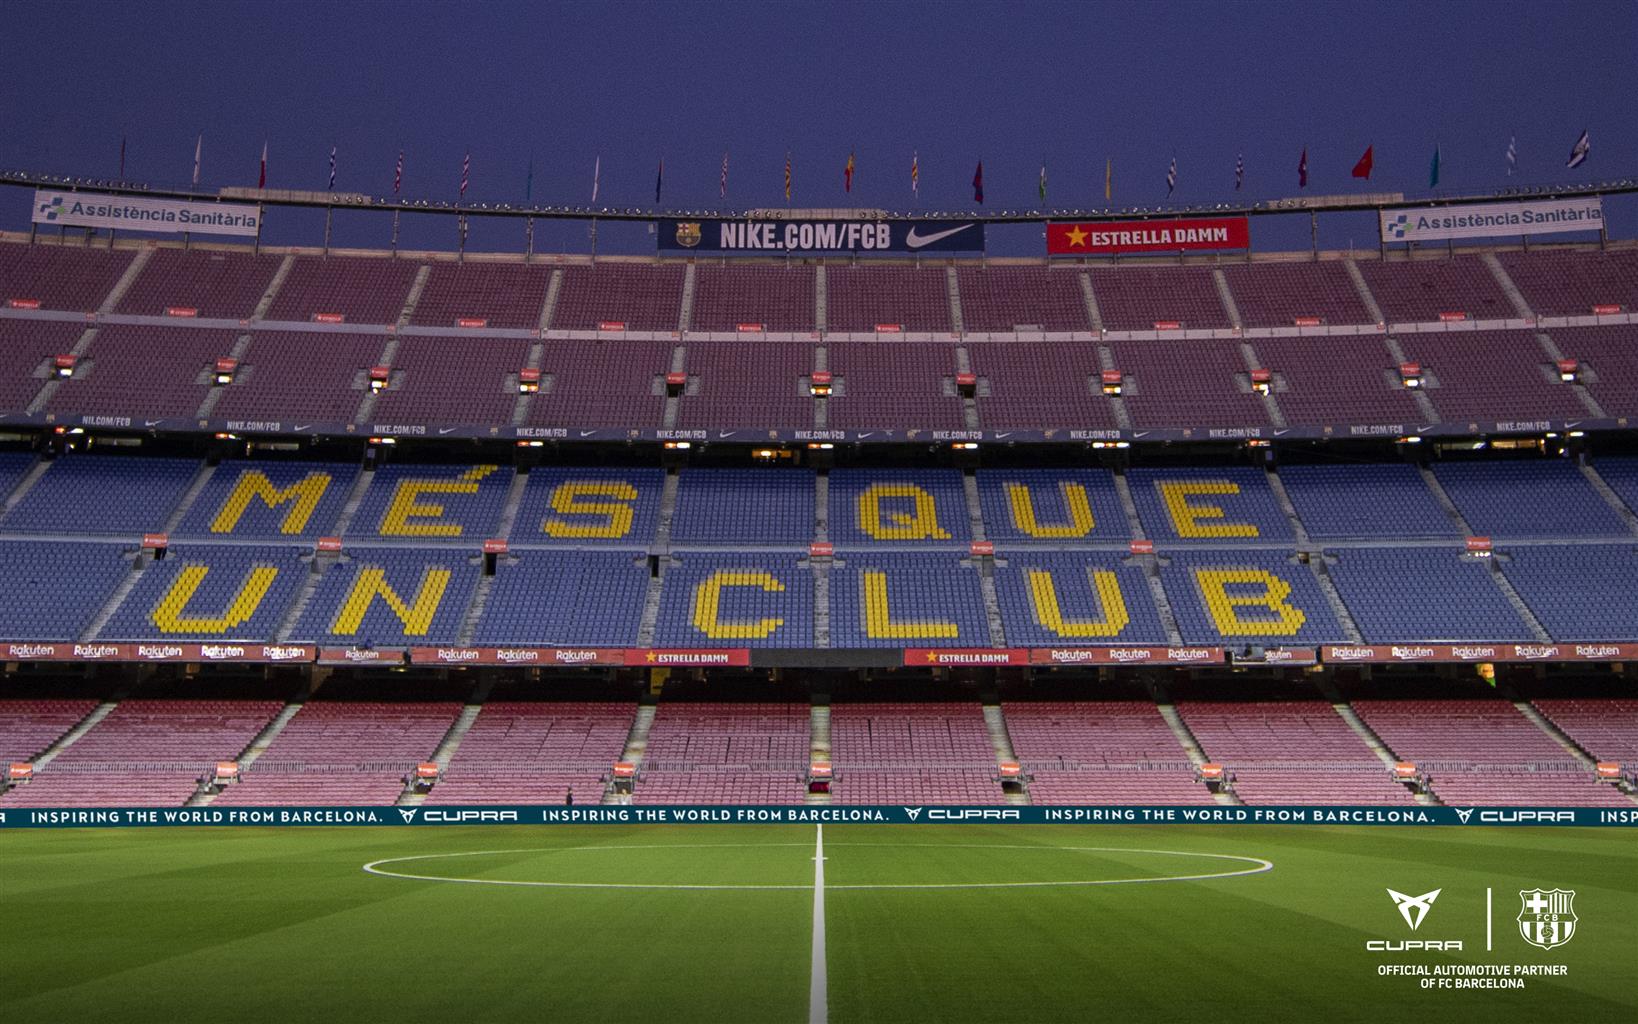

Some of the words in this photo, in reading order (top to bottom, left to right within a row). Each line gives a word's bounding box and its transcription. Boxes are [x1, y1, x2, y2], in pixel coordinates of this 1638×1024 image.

[70, 201, 175, 223] Assistència
[178, 208, 257, 229] Sanitària
[1417, 209, 1519, 231] Assistència
[1521, 205, 1602, 223] Sanitària
[720, 223, 891, 250] NIKE.COM/FCB
[1091, 230, 1172, 247] ESTRELLA
[1174, 227, 1228, 244] DAMM
[227, 421, 280, 432] NIKE.COM/FCB
[374, 424, 426, 436] NIKE.COM/FCB
[1351, 425, 1403, 437] NIKE.COM/FCB
[1497, 421, 1550, 434] NIKE.COM/FCB
[517, 428, 567, 440] NIKE.COM/FCB
[657, 430, 706, 441] NIKE.COM/FCB
[795, 430, 845, 441] NIKE.COM/FCB
[933, 430, 982, 441] NIKE.COM/FCB
[1070, 430, 1121, 441] NIKE.COM/FCB
[1209, 428, 1261, 440] NIKE.COM/FCB
[208, 464, 638, 539] MÉS
[856, 480, 1259, 540] QUE
[150, 564, 451, 635] UN
[688, 566, 1306, 639] CLUB
[9, 644, 55, 657] Rakuten
[73, 644, 118, 657] Rakuten
[138, 644, 182, 657] Rakuten
[201, 644, 244, 657] Rakuten
[262, 645, 305, 658] Rakuten
[345, 650, 379, 660] Rakuten
[438, 647, 479, 660] Rakuten
[497, 648, 538, 660] Rakuten
[556, 648, 597, 660] Rakuten
[1051, 646, 1092, 659] Rakuten
[1109, 646, 1150, 658] Rakuten
[1167, 646, 1209, 659] Rakuten
[1331, 645, 1374, 658] Rakuten
[1391, 645, 1434, 658] Rakuten
[1452, 645, 1495, 658] Rakuten
[1515, 645, 1561, 658] Rakuten
[1575, 645, 1619, 657] Rakuten
[658, 652, 699, 663] ESTRELLA
[699, 651, 728, 662] DAMM
[939, 652, 981, 663] ESTRELLA
[981, 651, 1009, 662] DAMM
[31, 811, 119, 823] INSPIRING
[126, 811, 158, 823] THE
[164, 811, 223, 823] WORLD
[229, 811, 274, 823] FROM
[281, 811, 383, 823] BARCELONA.
[423, 810, 518, 822] CUPRA
[543, 810, 629, 821] INSPIRING
[635, 810, 666, 821] THE
[672, 810, 731, 821] WORLD
[737, 810, 781, 821] FROM
[788, 810, 889, 821] BARCELONA.
[928, 809, 1020, 819] CUPRA
[1045, 809, 1135, 820] INSPIRING
[1142, 809, 1175, 820] THE
[1182, 810, 1247, 821] WORLD
[1255, 810, 1305, 821] FROM
[1313, 810, 1435, 823] BARCELONA.
[1480, 811, 1575, 822] CUPRA
